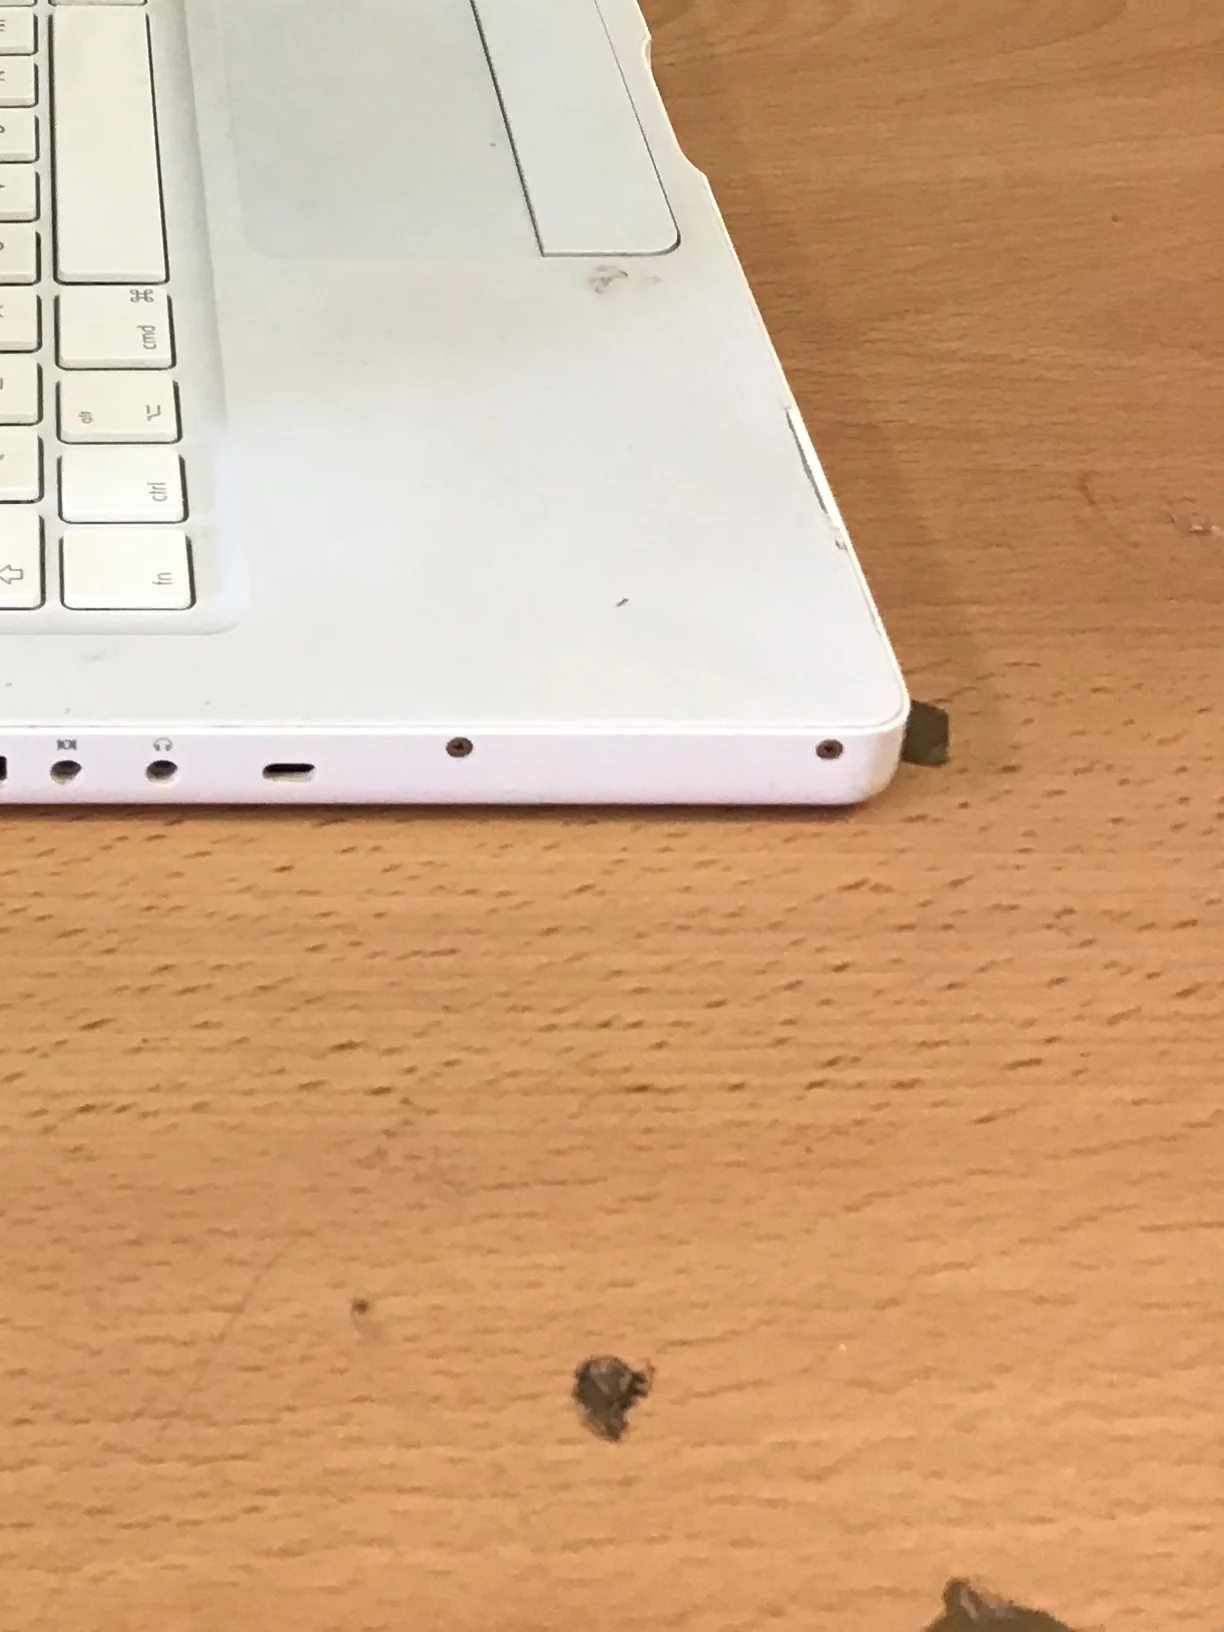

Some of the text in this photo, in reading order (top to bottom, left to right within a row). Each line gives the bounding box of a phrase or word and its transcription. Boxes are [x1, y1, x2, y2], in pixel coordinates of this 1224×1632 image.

[137, 325, 156, 350] cmd
[147, 482, 167, 502] ctrl
[152, 572, 172, 585] fn
